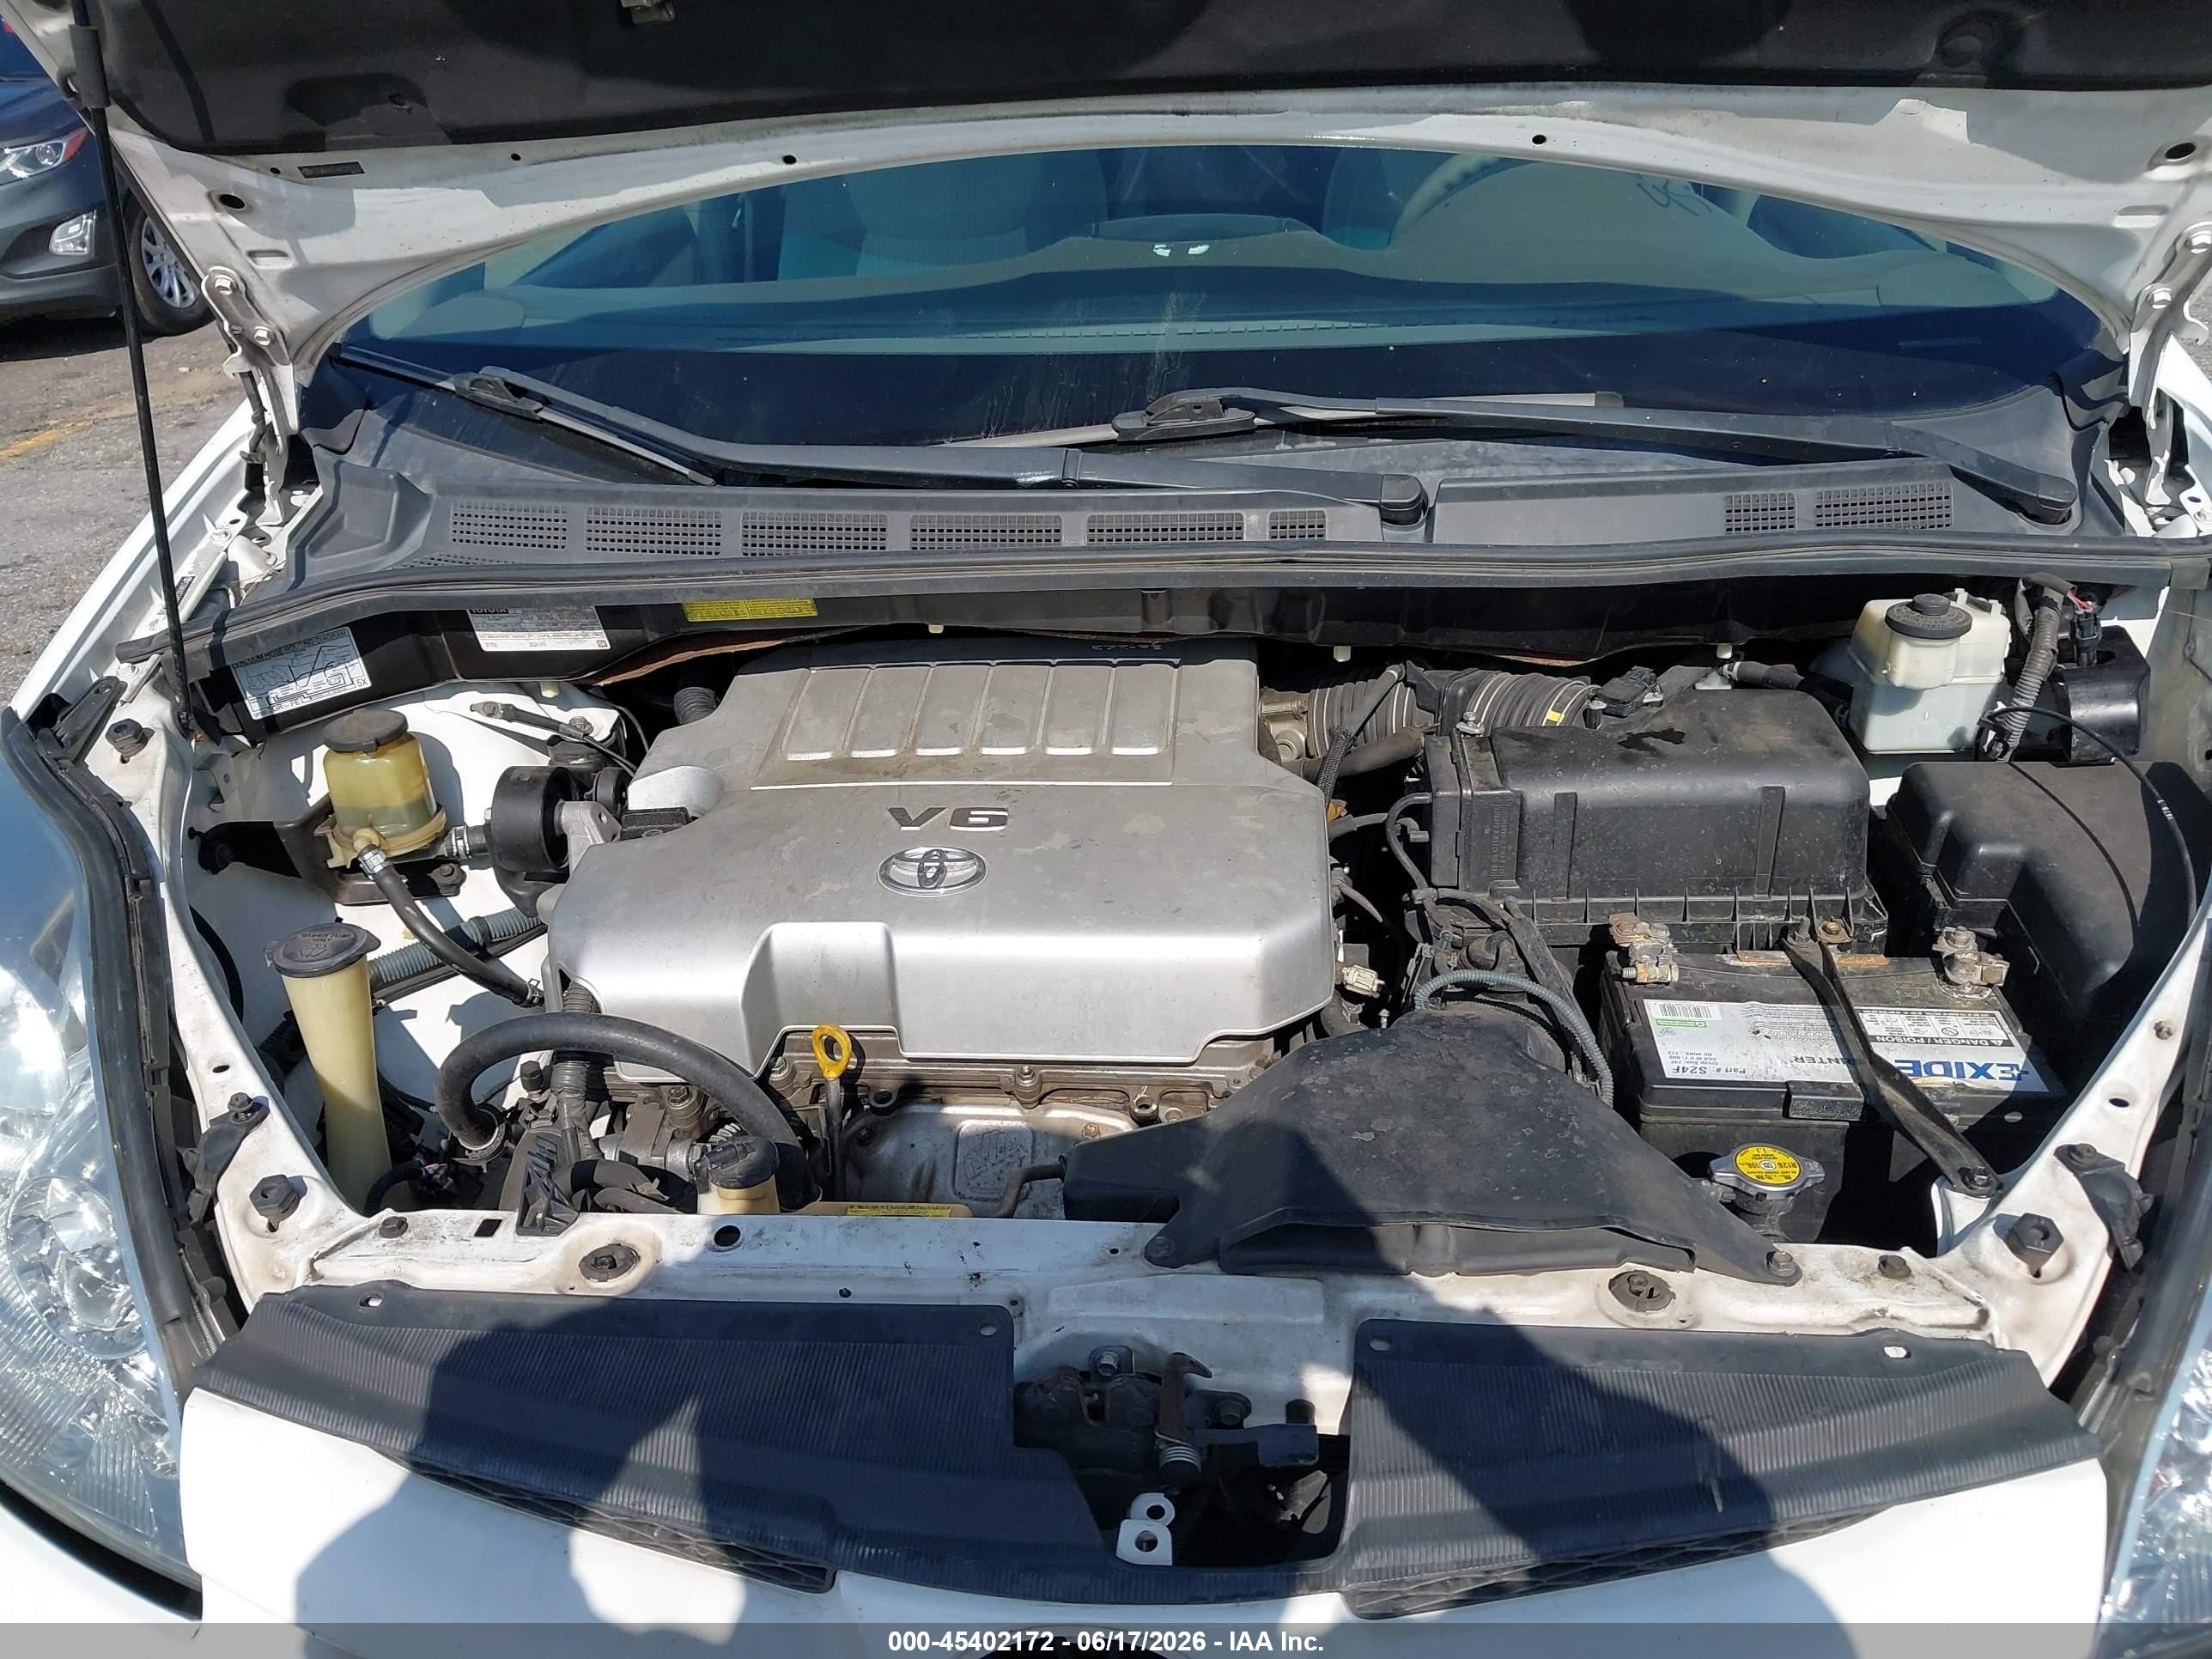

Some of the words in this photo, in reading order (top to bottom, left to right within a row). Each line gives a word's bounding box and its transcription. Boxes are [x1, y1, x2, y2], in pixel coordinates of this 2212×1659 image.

[356, 678, 368, 688] 5X
[887, 806, 1008, 831] V6
[1876, 1036, 1923, 1044] POISON
[1934, 1037, 1989, 1046] DANGER
[1794, 1055, 1856, 1066] RINTER
[1672, 1066, 1707, 1074] S24F
[1895, 1059, 2029, 1081] EXIDE
